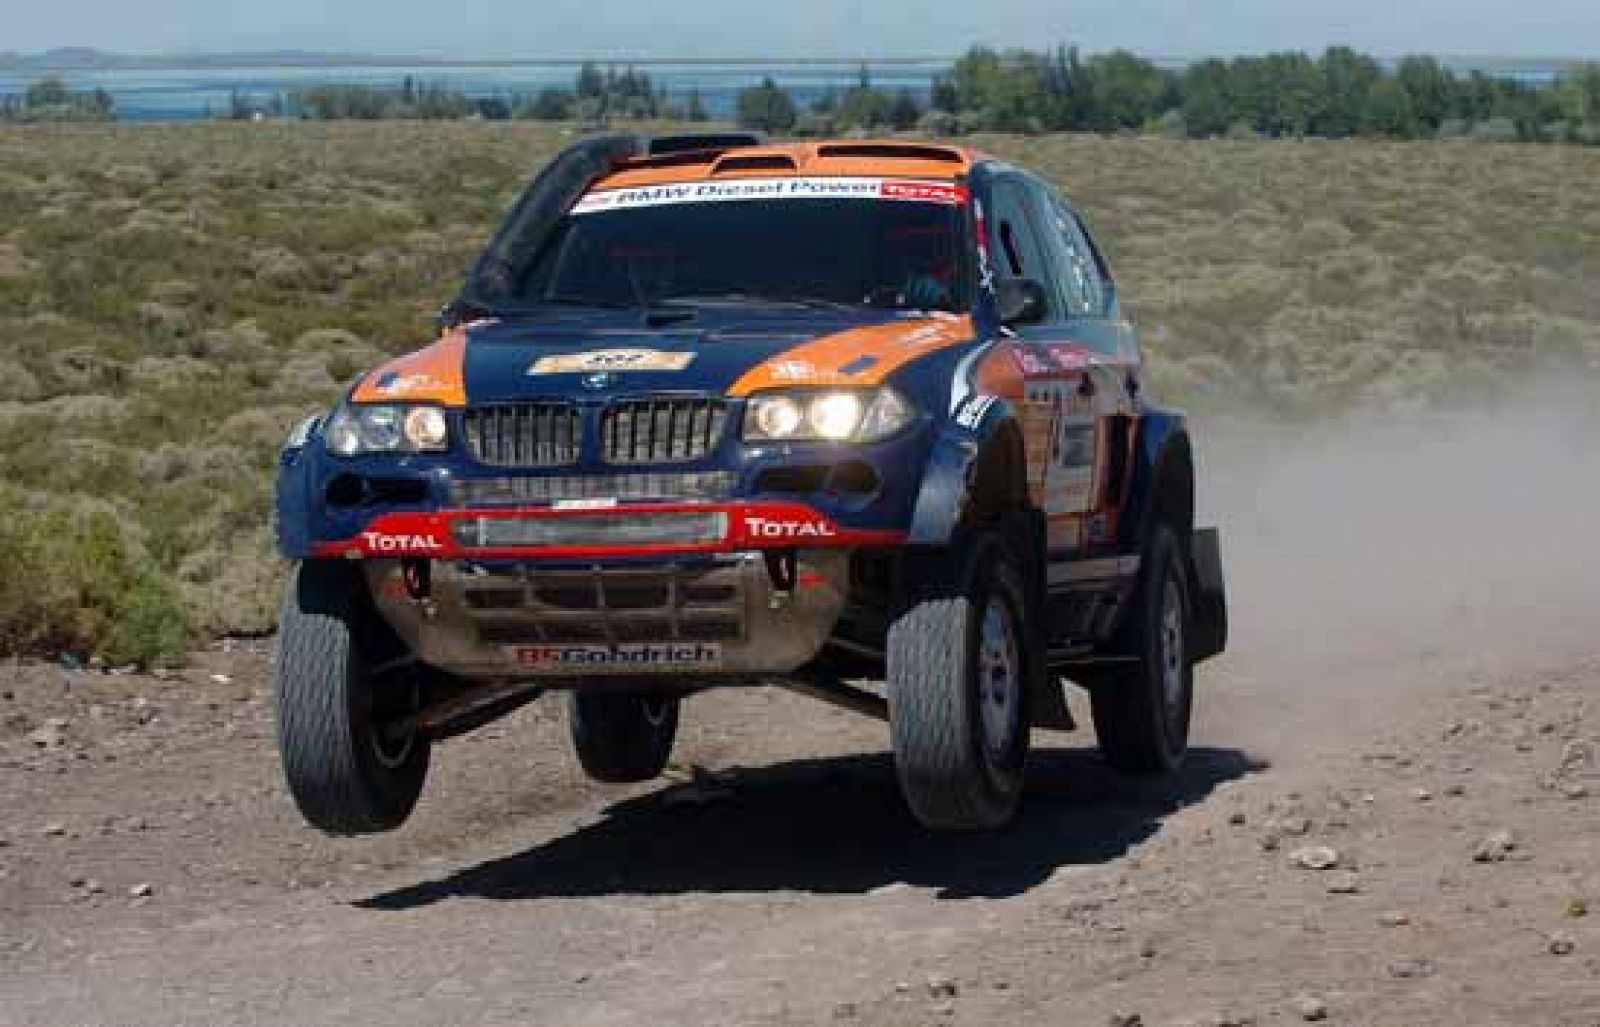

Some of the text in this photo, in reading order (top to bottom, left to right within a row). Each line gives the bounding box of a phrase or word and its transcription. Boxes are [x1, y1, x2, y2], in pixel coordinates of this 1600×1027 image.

[697, 181, 783, 197] Diesel
[790, 181, 877, 195] Power
[744, 517, 836, 536] TOTAL
[361, 531, 443, 550] TOTAL
